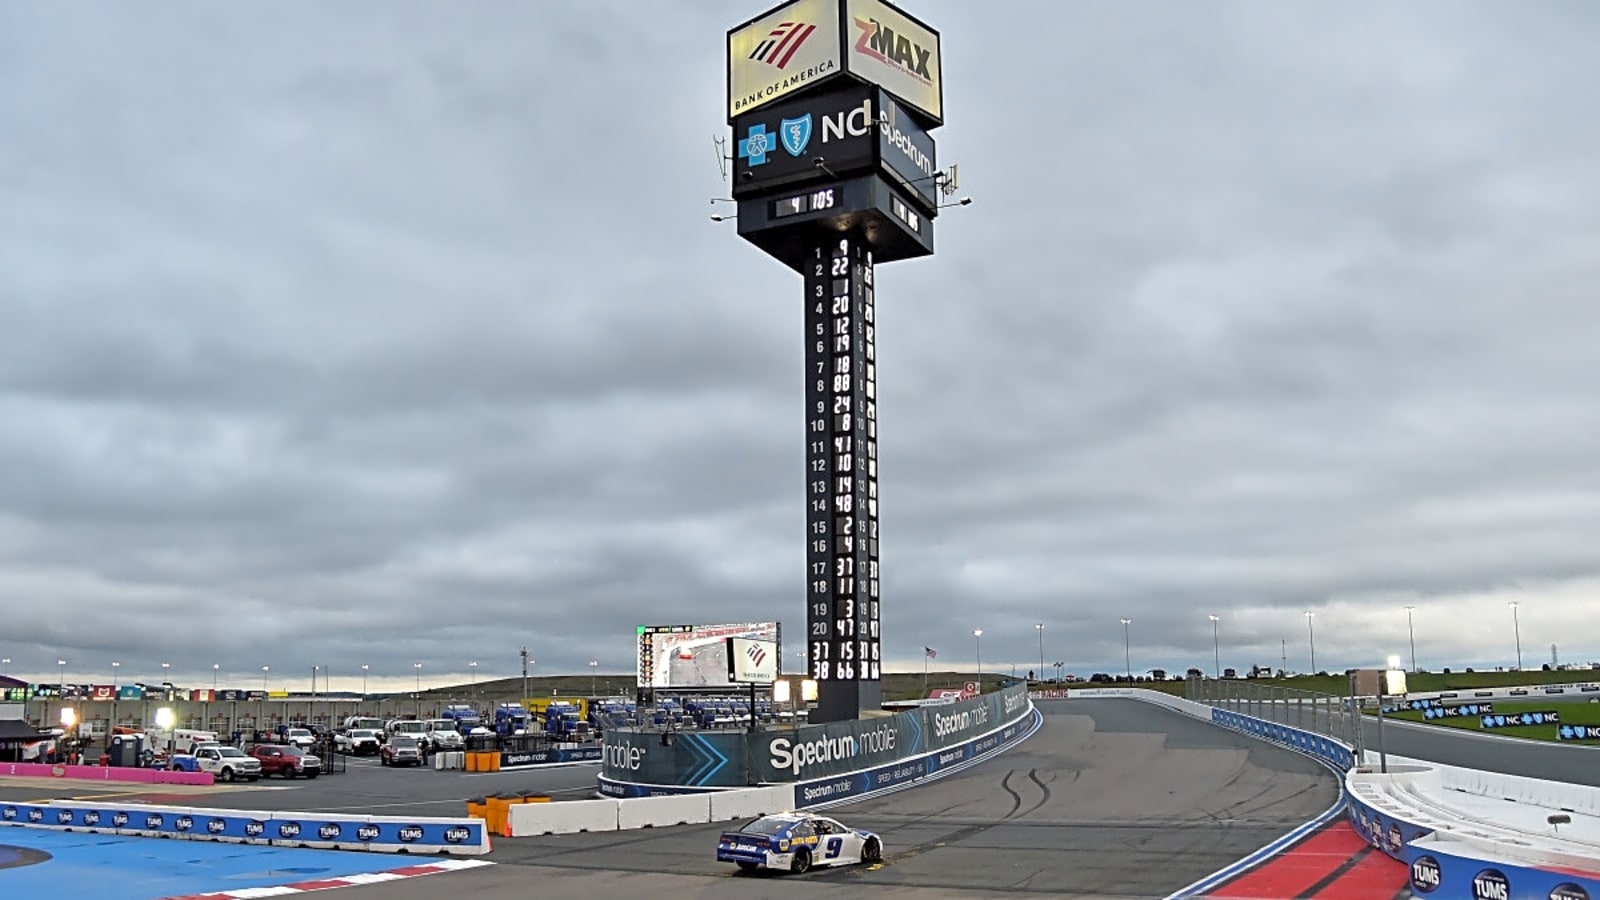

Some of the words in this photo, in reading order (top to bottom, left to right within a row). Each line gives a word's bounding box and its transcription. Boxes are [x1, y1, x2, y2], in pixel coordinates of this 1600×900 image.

[735, 92, 763, 110] BANK
[766, 83, 780, 96] OF
[782, 59, 834, 90] AMERICA
[822, 107, 867, 143] NC
[880, 110, 932, 176] Spectrum
[791, 196, 800, 213] 4
[812, 189, 834, 210] 105
[815, 247, 821, 259] 1
[840, 239, 848, 256] 9
[815, 264, 824, 276] 2
[832, 257, 849, 276] 22
[815, 285, 823, 297] 3
[844, 278, 849, 295] 1
[815, 302, 823, 314] 4
[832, 295, 849, 315] 20
[816, 323, 824, 335] 5
[836, 316, 850, 334] 12
[816, 341, 824, 353] 6
[837, 334, 850, 352] 19
[816, 362, 824, 374] 7
[837, 355, 850, 374] 18
[816, 380, 824, 392] 8
[833, 373, 850, 393] 88
[817, 401, 825, 413] 9
[834, 395, 851, 414] 24
[810, 419, 825, 432] 10
[842, 413, 851, 431] 8
[811, 441, 824, 454] 11
[834, 435, 851, 453] 41
[811, 459, 826, 472] 12
[838, 453, 852, 472] 10
[811, 480, 826, 493] 13
[839, 476, 852, 493] 14
[812, 499, 826, 512] 14
[835, 494, 852, 513] 48
[812, 521, 826, 534] 15
[843, 516, 853, 534] 2
[812, 540, 826, 553] 16
[844, 535, 853, 553] 4
[812, 562, 826, 575] 17
[837, 556, 853, 577] 37
[813, 580, 827, 593] 18
[840, 577, 854, 594] 11
[812, 603, 827, 616] 19
[846, 599, 854, 618] 3
[812, 622, 827, 635] 20
[836, 618, 854, 637] 47
[813, 641, 829, 660] 37
[840, 641, 854, 660] 15
[813, 661, 829, 680] 38
[836, 661, 854, 680] 66
[1445, 708, 1458, 716] NC
[1480, 705, 1492, 713] NC
[1506, 716, 1520, 725] NC
[1544, 713, 1559, 722] NC
[935, 711, 969, 741] Spectrum
[1587, 727, 1600, 737] NC
[508, 754, 531, 763] Spectrum
[769, 733, 855, 775] Spectrum
[804, 784, 833, 800] Spectrum
[878, 771, 891, 784] SPEED
[246, 824, 264, 834] TUMS
[281, 826, 300, 835] TUMS
[320, 827, 340, 836] TUMS
[359, 829, 379, 838] TUMS
[400, 830, 422, 839] TUMS
[446, 831, 469, 840] TUMS
[825, 837, 843, 859] 9
[1413, 864, 1440, 885] TUMS
[1474, 879, 1508, 900] TUMS
